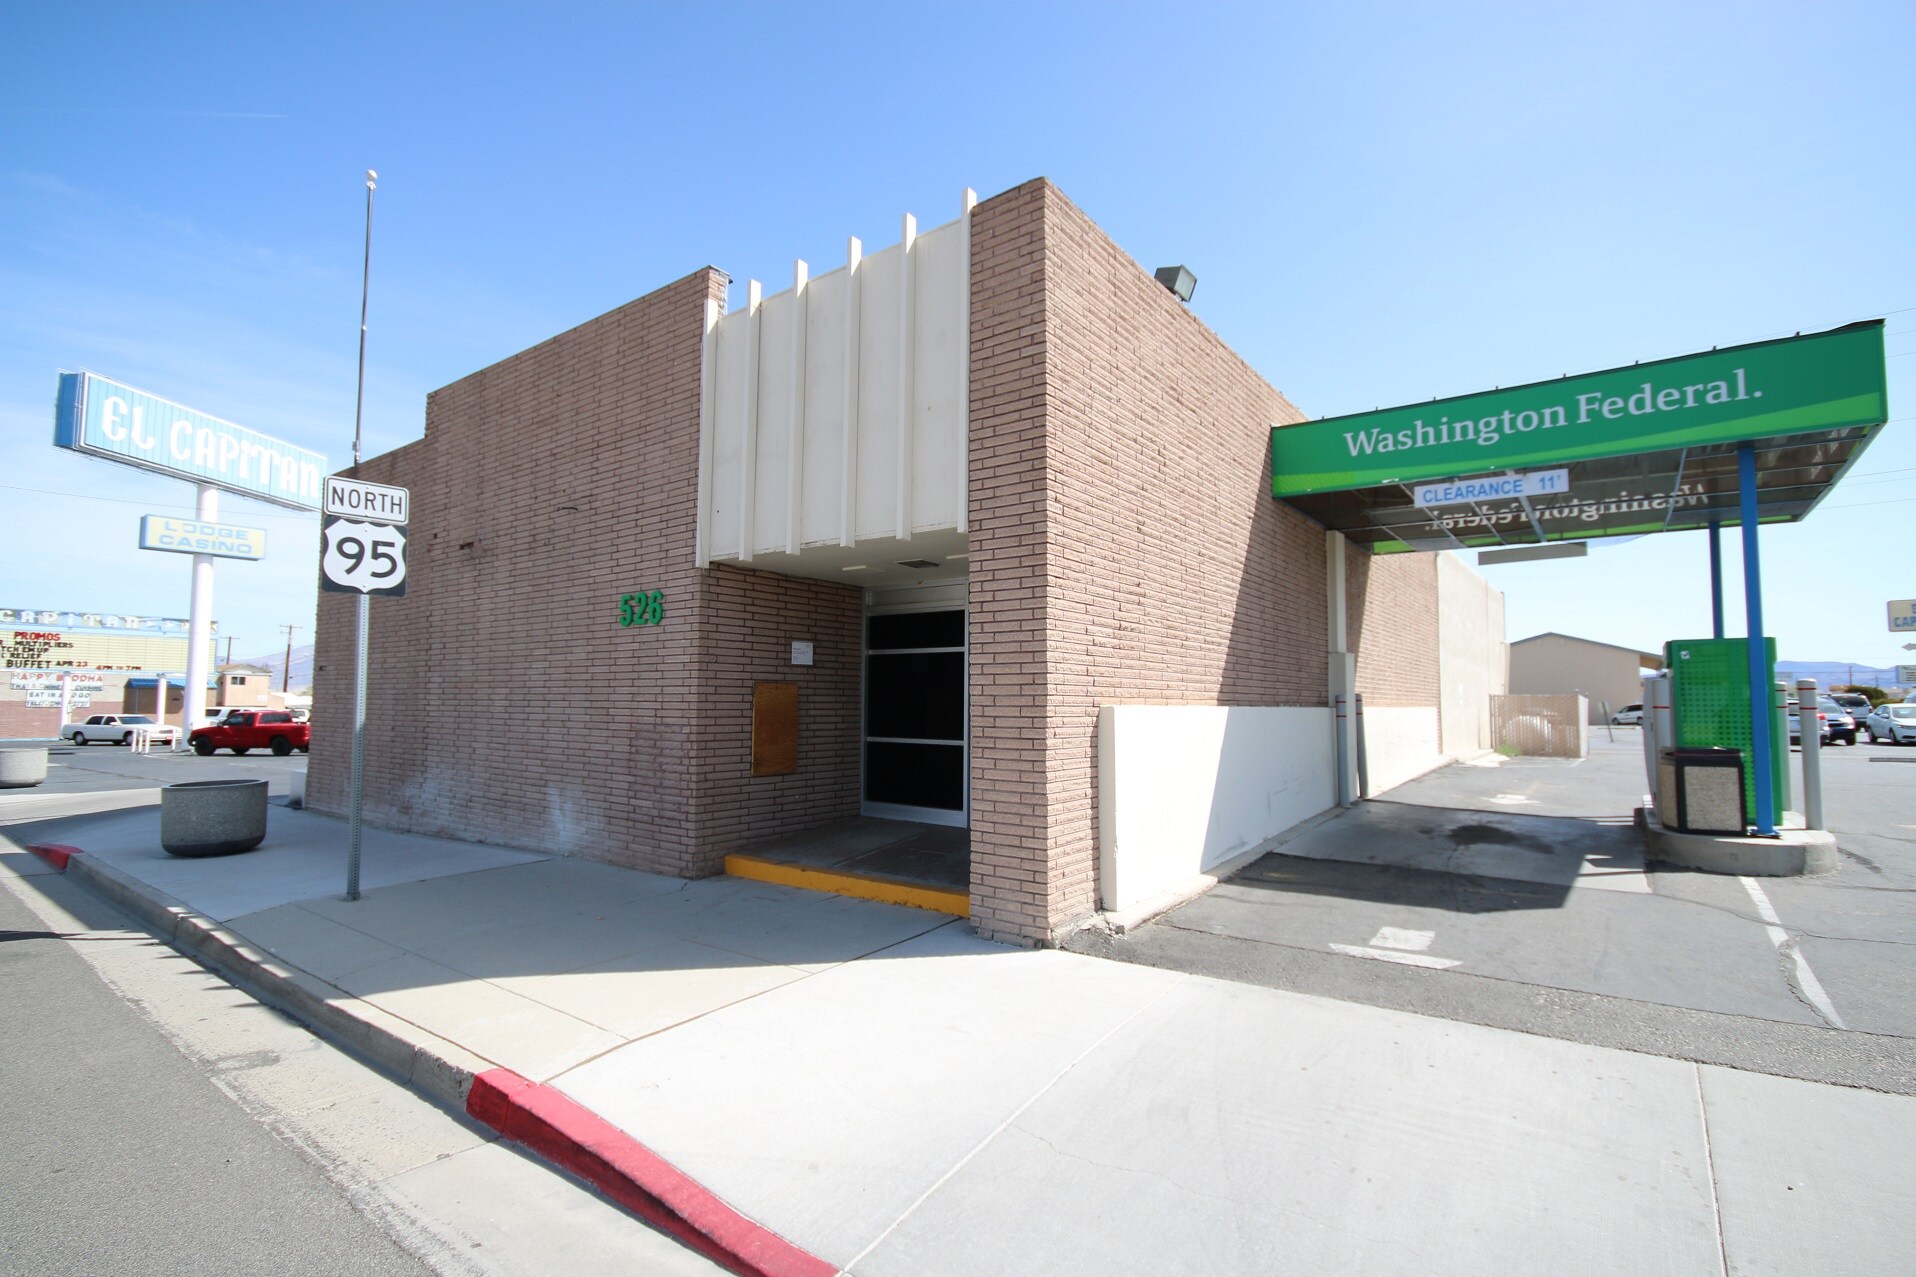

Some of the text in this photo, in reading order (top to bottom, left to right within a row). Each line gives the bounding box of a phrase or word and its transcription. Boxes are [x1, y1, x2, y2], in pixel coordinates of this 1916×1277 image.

[1343, 368, 1763, 457] Washington Federal.
[331, 486, 403, 516] NORTH
[1422, 479, 1523, 504] CLEARANCE
[164, 520, 250, 540] LODGE
[159, 534, 254, 555] CASINO
[336, 537, 398, 579] 95
[619, 591, 663, 627] 526
[14, 632, 61, 641] PROMOS
[6, 660, 51, 668] BUFFET
